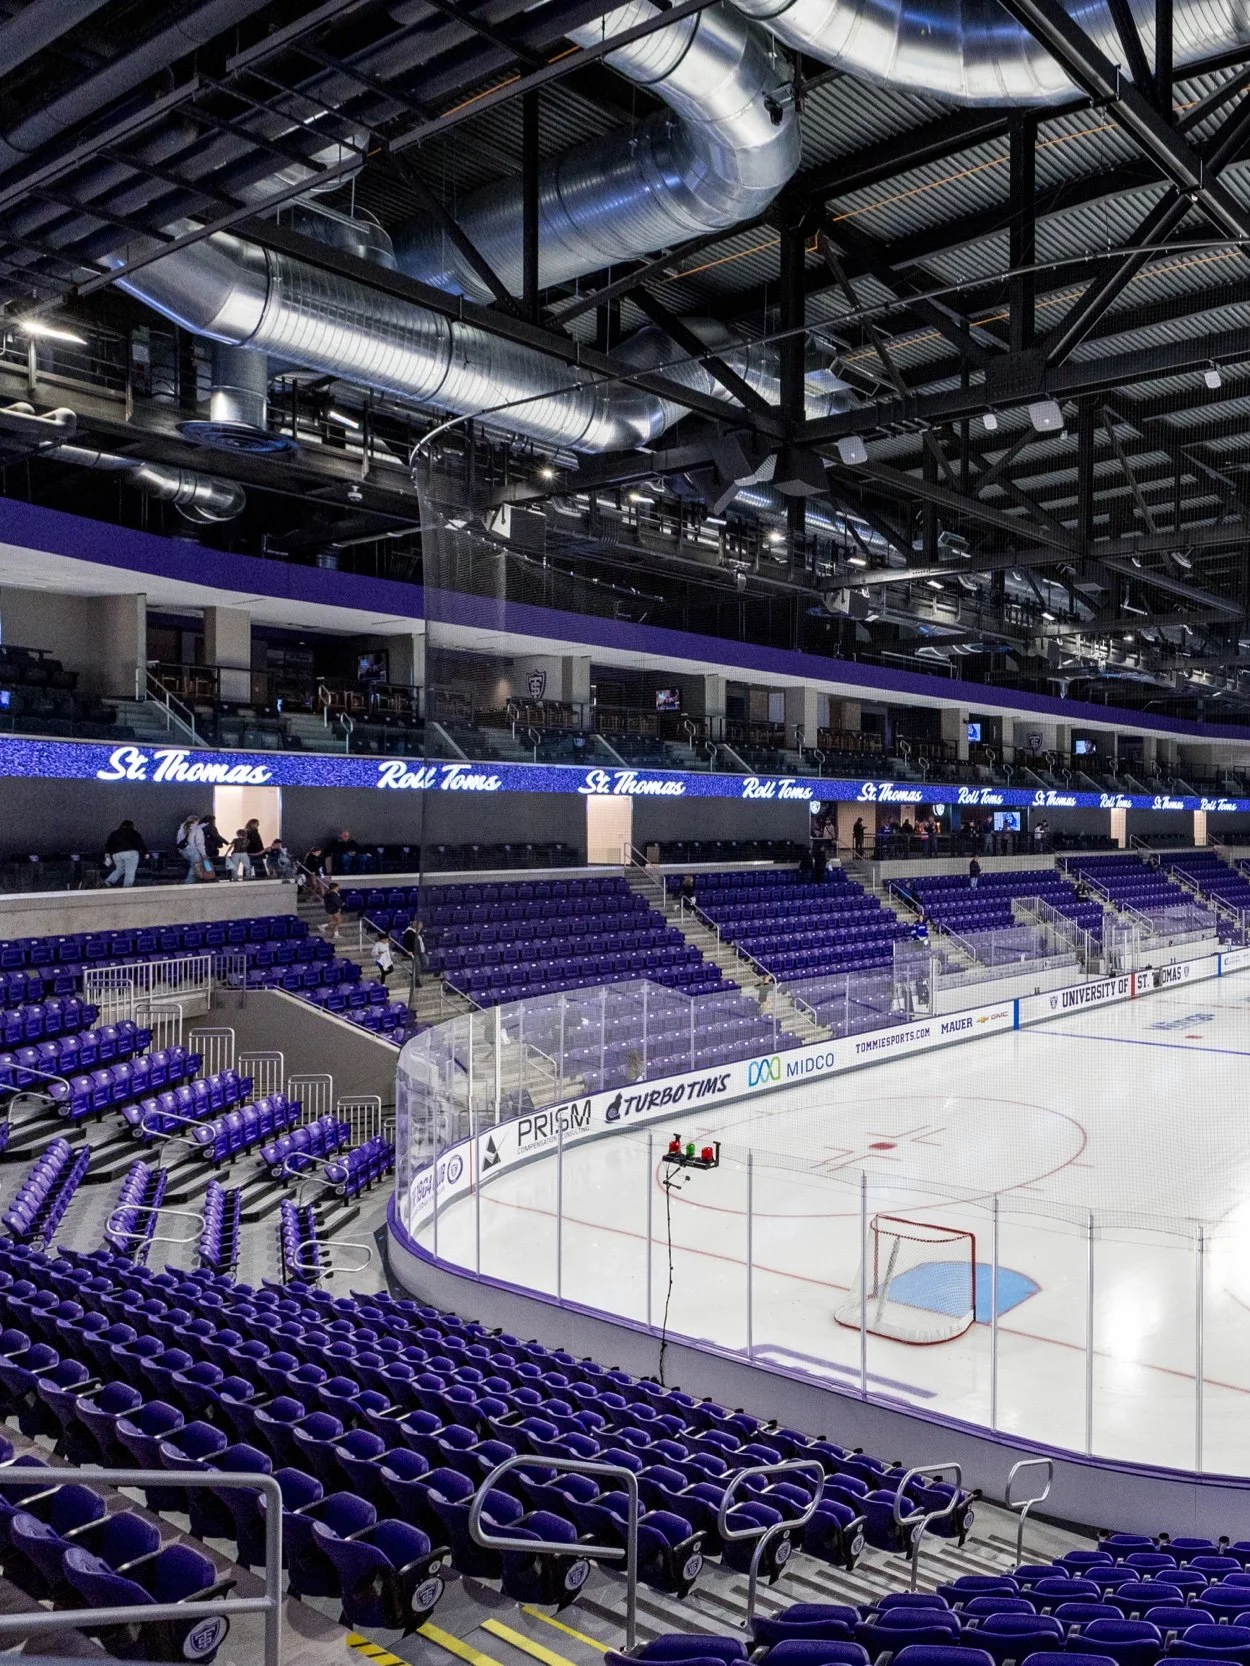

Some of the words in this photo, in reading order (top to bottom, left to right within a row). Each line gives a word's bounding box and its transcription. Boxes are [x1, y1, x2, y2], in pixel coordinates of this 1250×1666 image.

[153, 749, 273, 784] Thomas
[377, 760, 437, 790] Roll
[440, 764, 502, 791] Toms
[612, 770, 686, 796] Thomas
[742, 777, 775, 799] Roll
[777, 779, 814, 800] Toms
[878, 783, 923, 802] Thomas
[957, 786, 979, 804] Roll
[980, 787, 1004, 805] Toms
[1046, 790, 1077, 806] Thomas
[1099, 793, 1115, 808] Roll
[1115, 794, 1133, 809] Toms
[1162, 796, 1184, 810] Thomas
[1200, 798, 1217, 811] Roll
[1217, 798, 1238, 812] Toms
[1062, 981, 1116, 1007] UNIVERSITY
[1118, 978, 1128, 994] OF
[1137, 974, 1150, 989] ST.
[940, 1017, 973, 1035] MAUER
[855, 1027, 931, 1054] TOMMIESPORTS.COM
[787, 1052, 835, 1078] MIDCO
[624, 1082, 683, 1115] TURBO
[685, 1073, 731, 1100] TIM'S
[518, 1099, 592, 1146] PRISM
